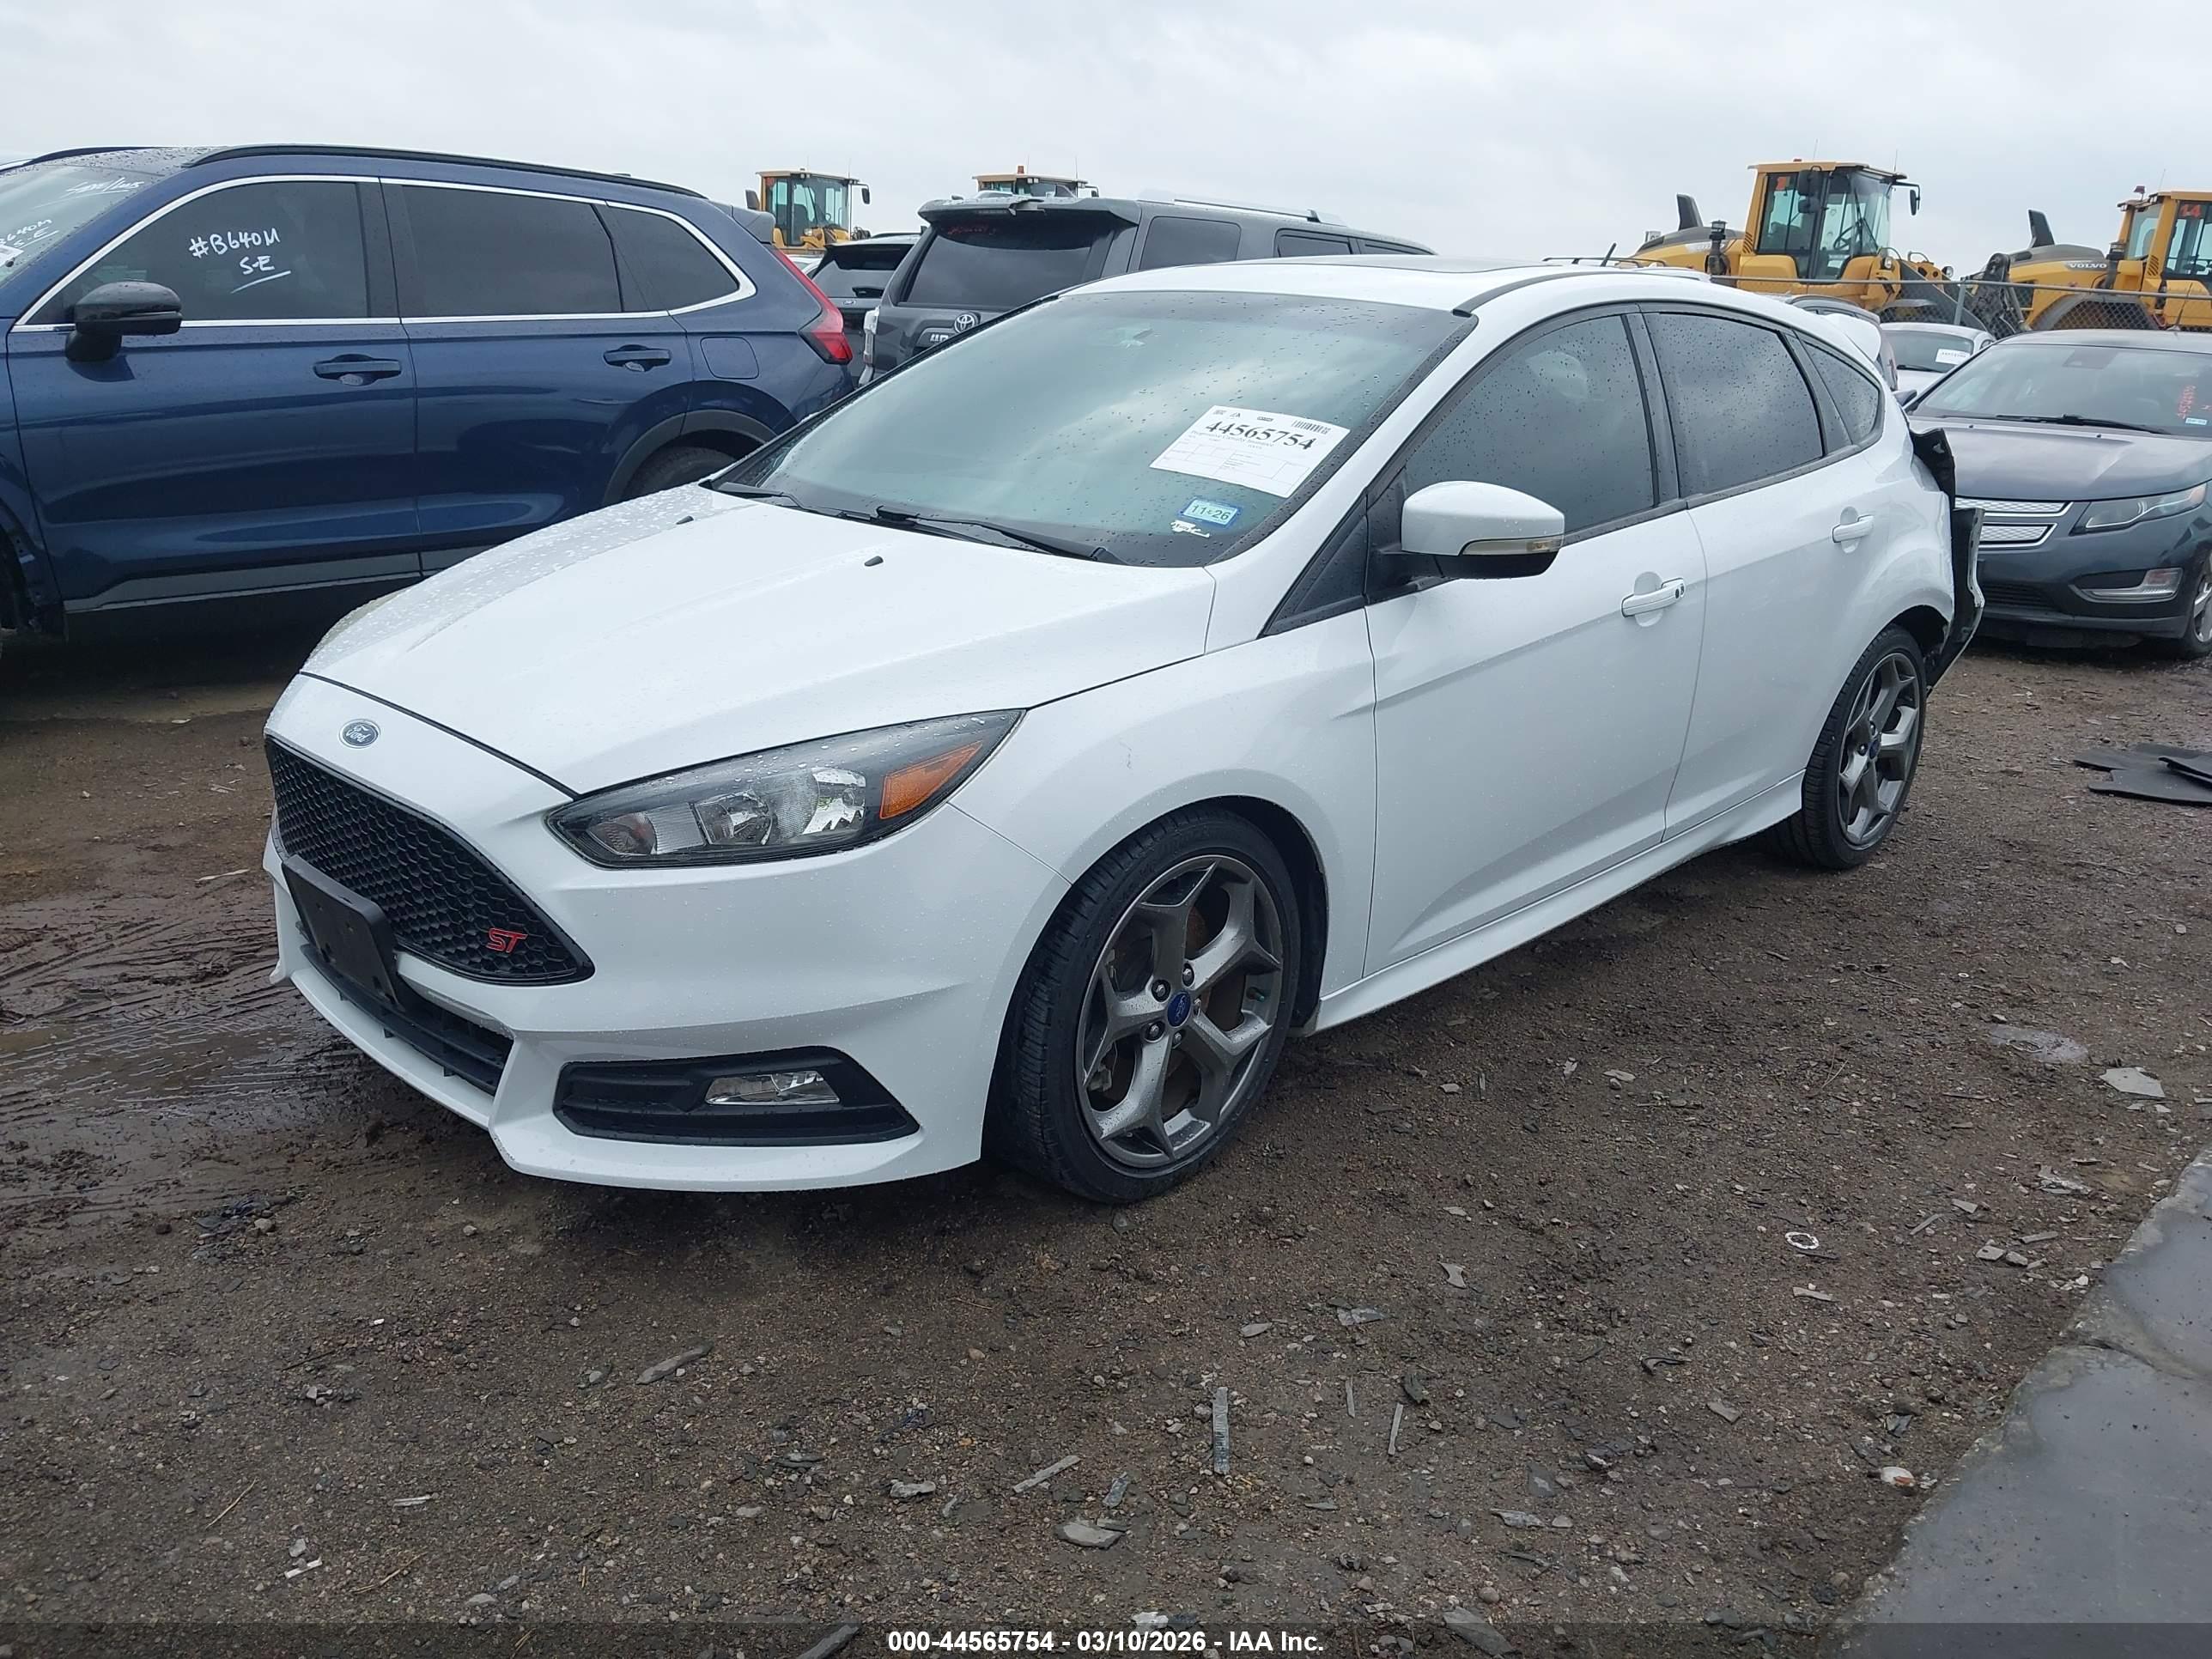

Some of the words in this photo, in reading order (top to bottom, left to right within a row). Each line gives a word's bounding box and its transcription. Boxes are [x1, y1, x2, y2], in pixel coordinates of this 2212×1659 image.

[189, 228, 280, 258] #B640M
[240, 255, 275, 275] S-E
[1206, 421, 1317, 450] 44565754
[345, 725, 371, 743] Ford
[485, 927, 529, 953] ST
